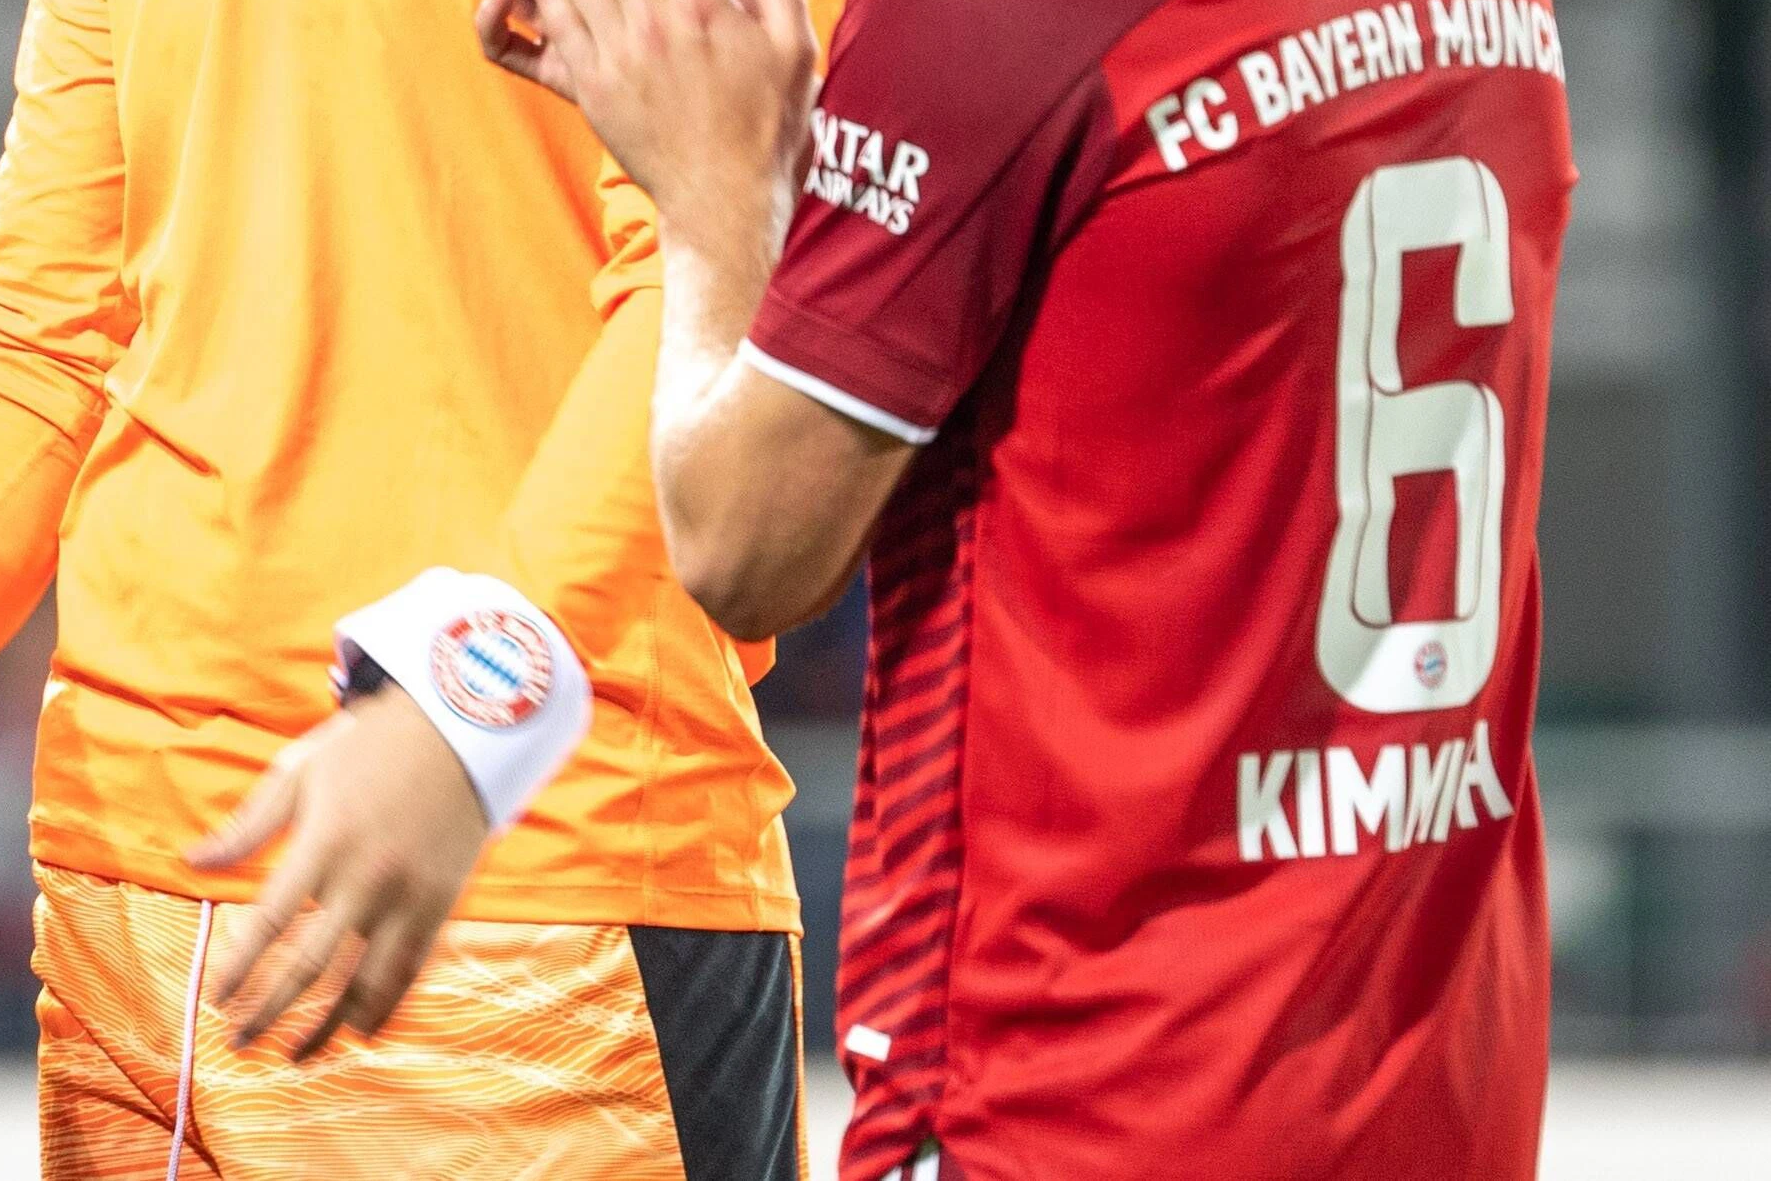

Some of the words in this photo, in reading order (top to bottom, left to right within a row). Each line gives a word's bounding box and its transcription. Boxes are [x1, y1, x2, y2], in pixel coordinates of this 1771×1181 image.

[1145, 77, 1239, 173] FC
[1238, 0, 1424, 128] BAYERN
[1316, 155, 1515, 713] 6
